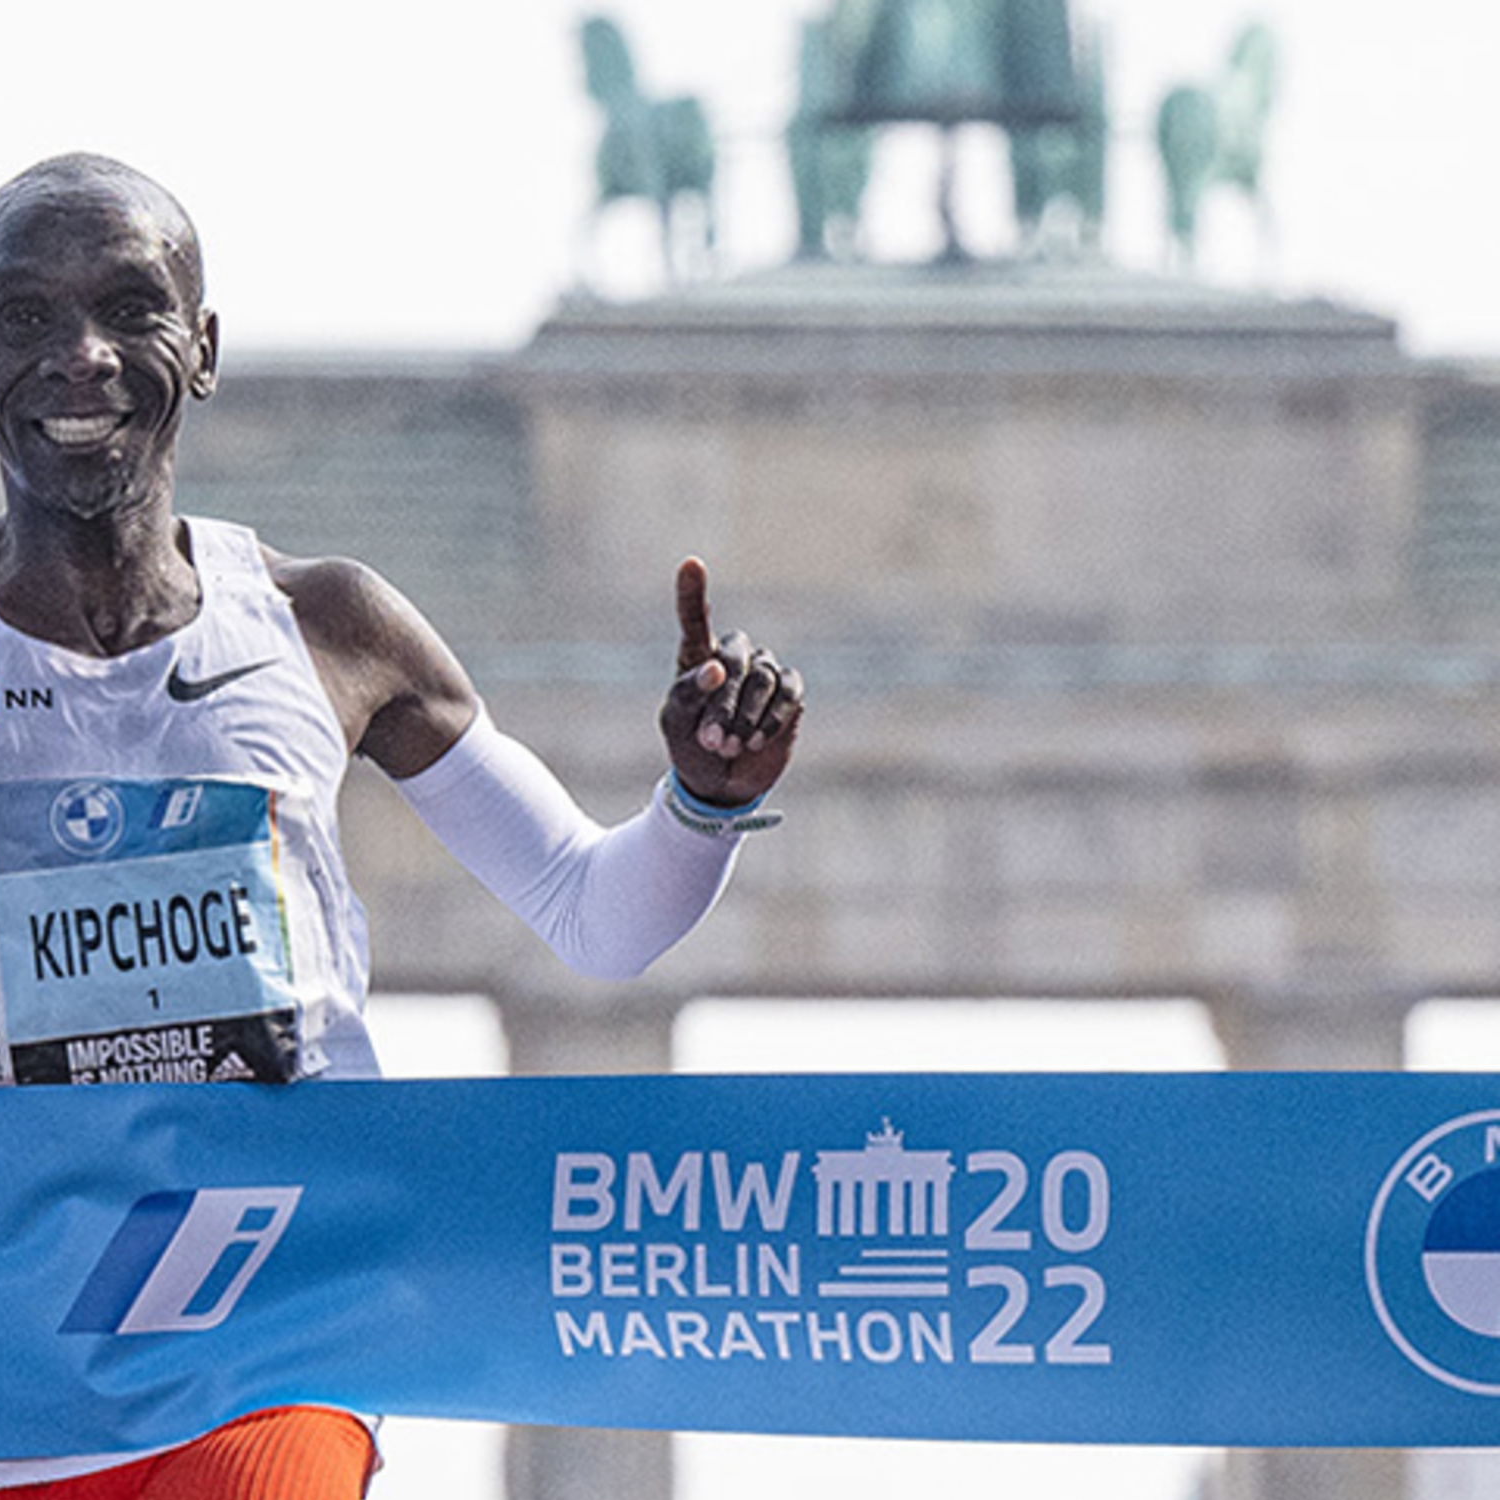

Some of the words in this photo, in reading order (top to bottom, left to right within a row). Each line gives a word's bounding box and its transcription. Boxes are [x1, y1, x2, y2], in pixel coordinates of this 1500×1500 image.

[5, 688, 53, 709] NN
[30, 887, 257, 980] KIPCHOGE
[148, 988, 160, 1010] 1
[66, 1025, 214, 1071] IMPOSSIBLE
[552, 1151, 800, 1232] BMW
[965, 1151, 1109, 1252] 20
[551, 1244, 800, 1297] BERLIN
[556, 1312, 954, 1364] MARATHON
[967, 1266, 1111, 1364] 22
